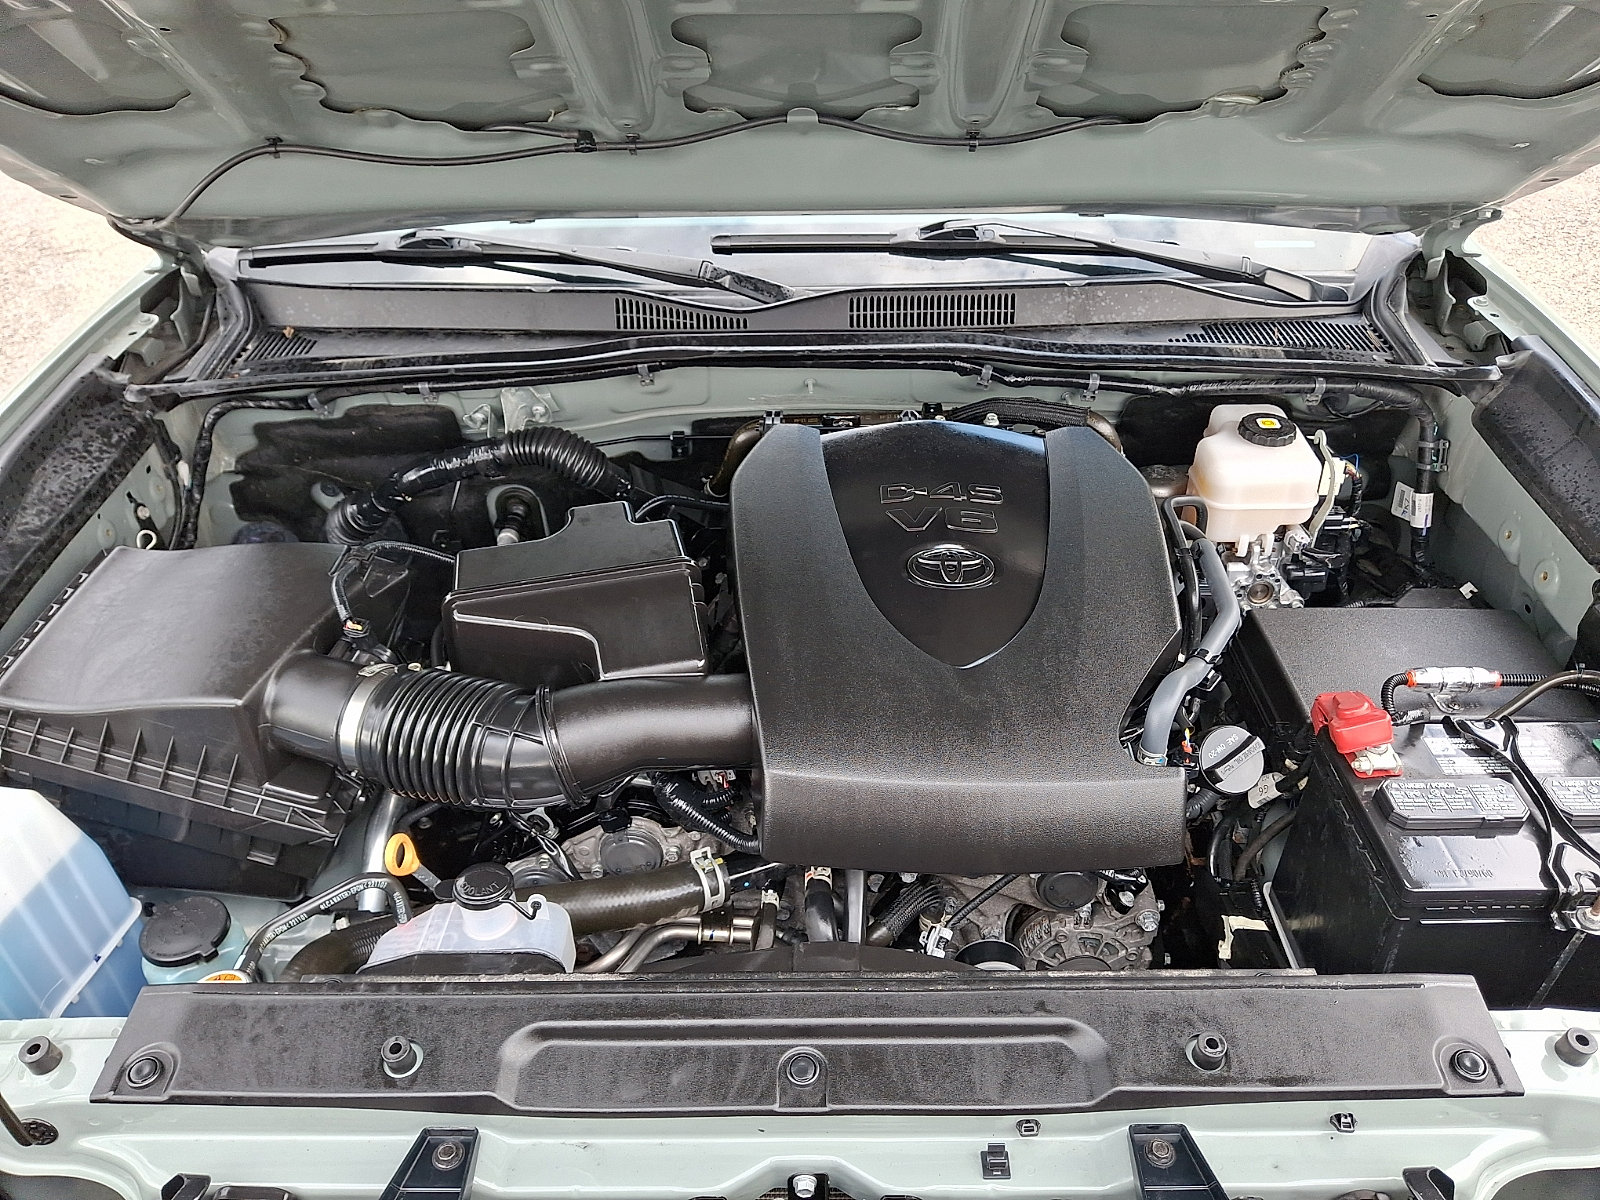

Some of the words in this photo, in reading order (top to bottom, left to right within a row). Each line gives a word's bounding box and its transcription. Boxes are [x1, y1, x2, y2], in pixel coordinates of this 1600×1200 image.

[879, 482, 1003, 504] D-4S
[885, 507, 998, 533] V6
[1226, 733, 1239, 746] SAE
[1208, 744, 1226, 759] 0W-20
[460, 881, 500, 896] COOLANT
